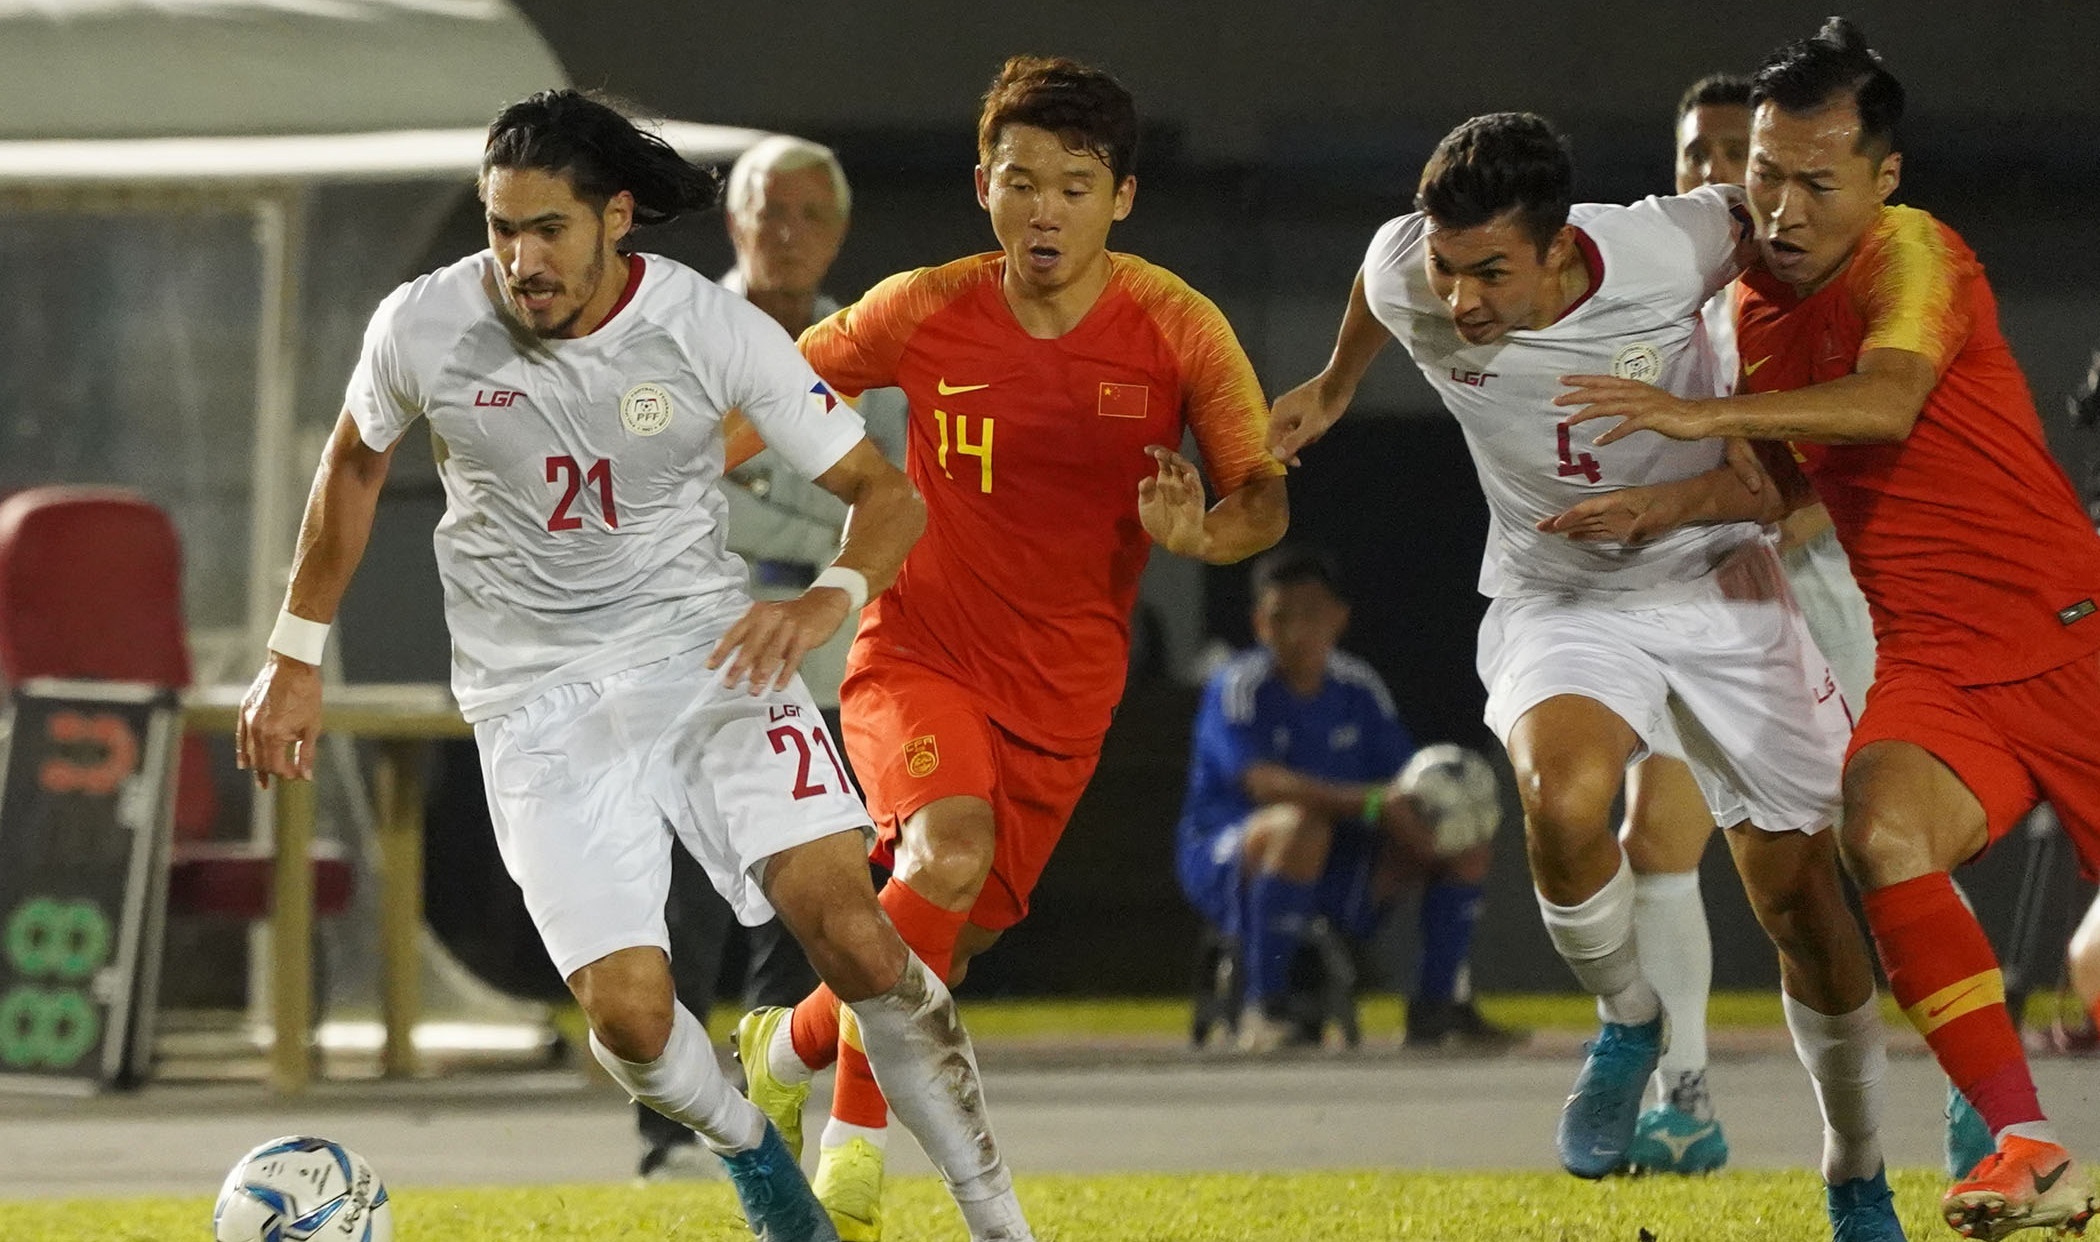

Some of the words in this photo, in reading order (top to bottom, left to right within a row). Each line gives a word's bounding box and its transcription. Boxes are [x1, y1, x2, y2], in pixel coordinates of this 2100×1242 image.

[637, 412, 661, 421] PFF
[934, 409, 994, 494] 14
[1556, 422, 1602, 484] 4
[545, 455, 618, 532] 21
[766, 725, 850, 800] 21
